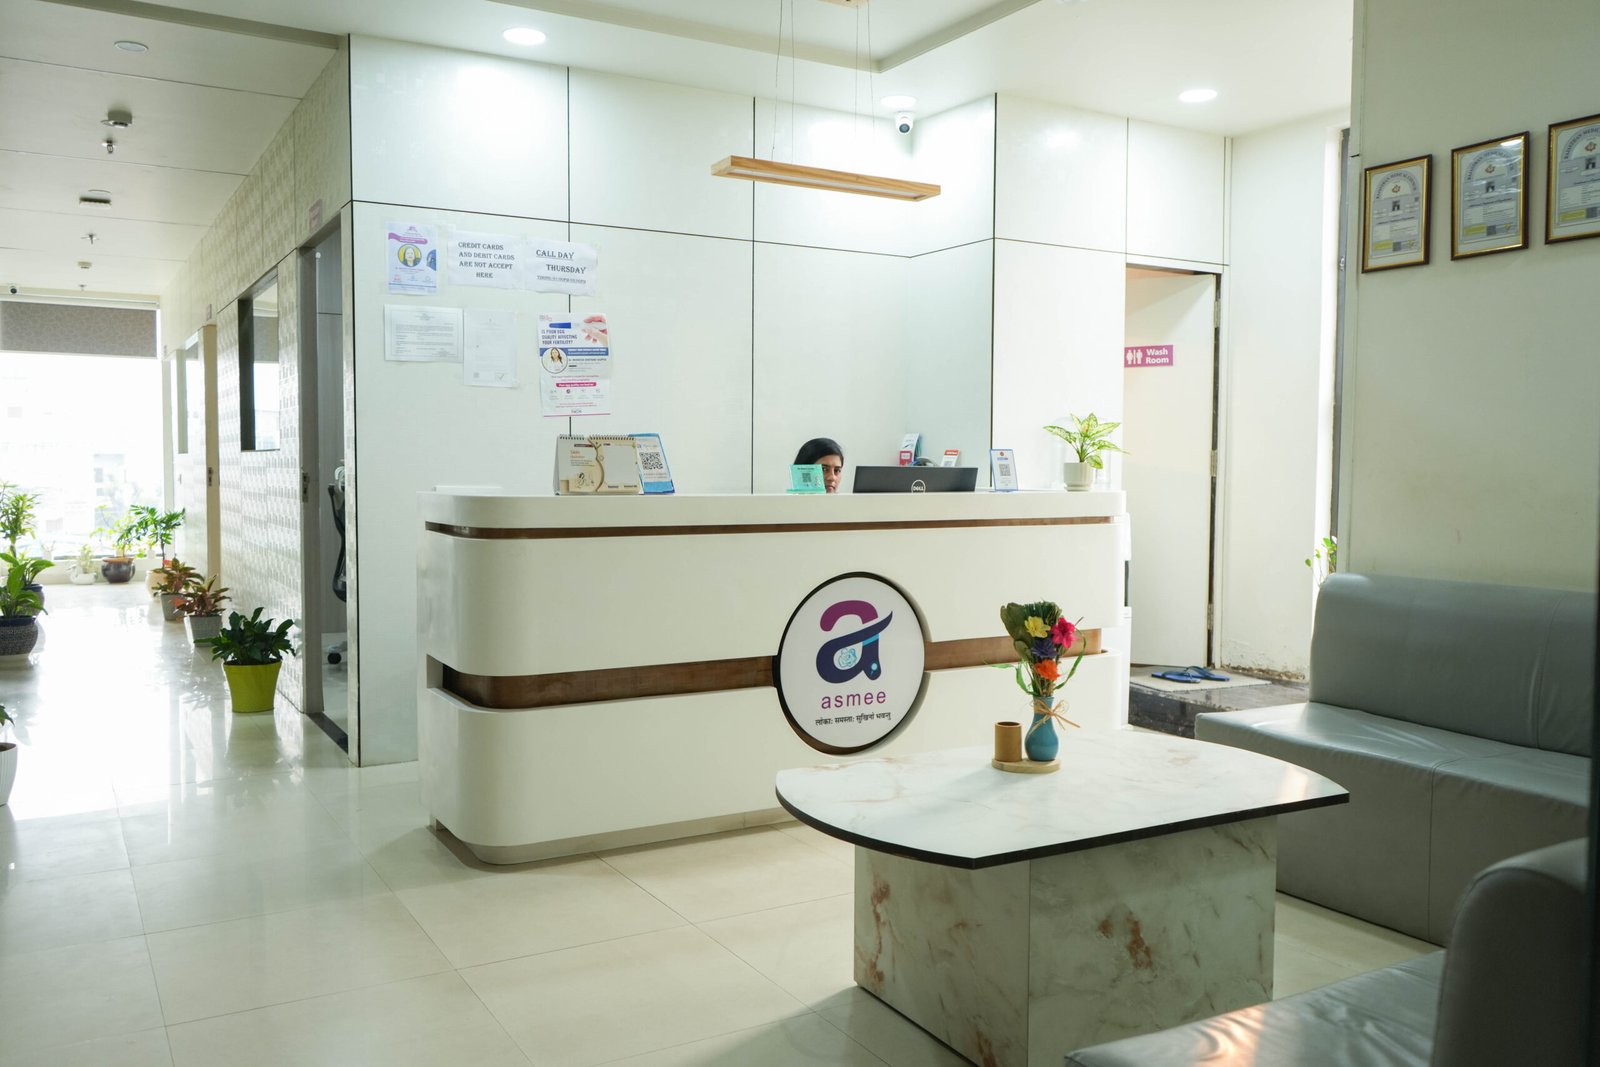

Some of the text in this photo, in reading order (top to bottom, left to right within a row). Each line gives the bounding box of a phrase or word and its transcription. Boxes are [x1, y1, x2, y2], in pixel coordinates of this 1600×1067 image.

[536, 250, 574, 260] CALL DAY
[546, 264, 586, 274] THURSDAY
[1146, 348, 1168, 356] Wash
[821, 691, 886, 710] asmee
